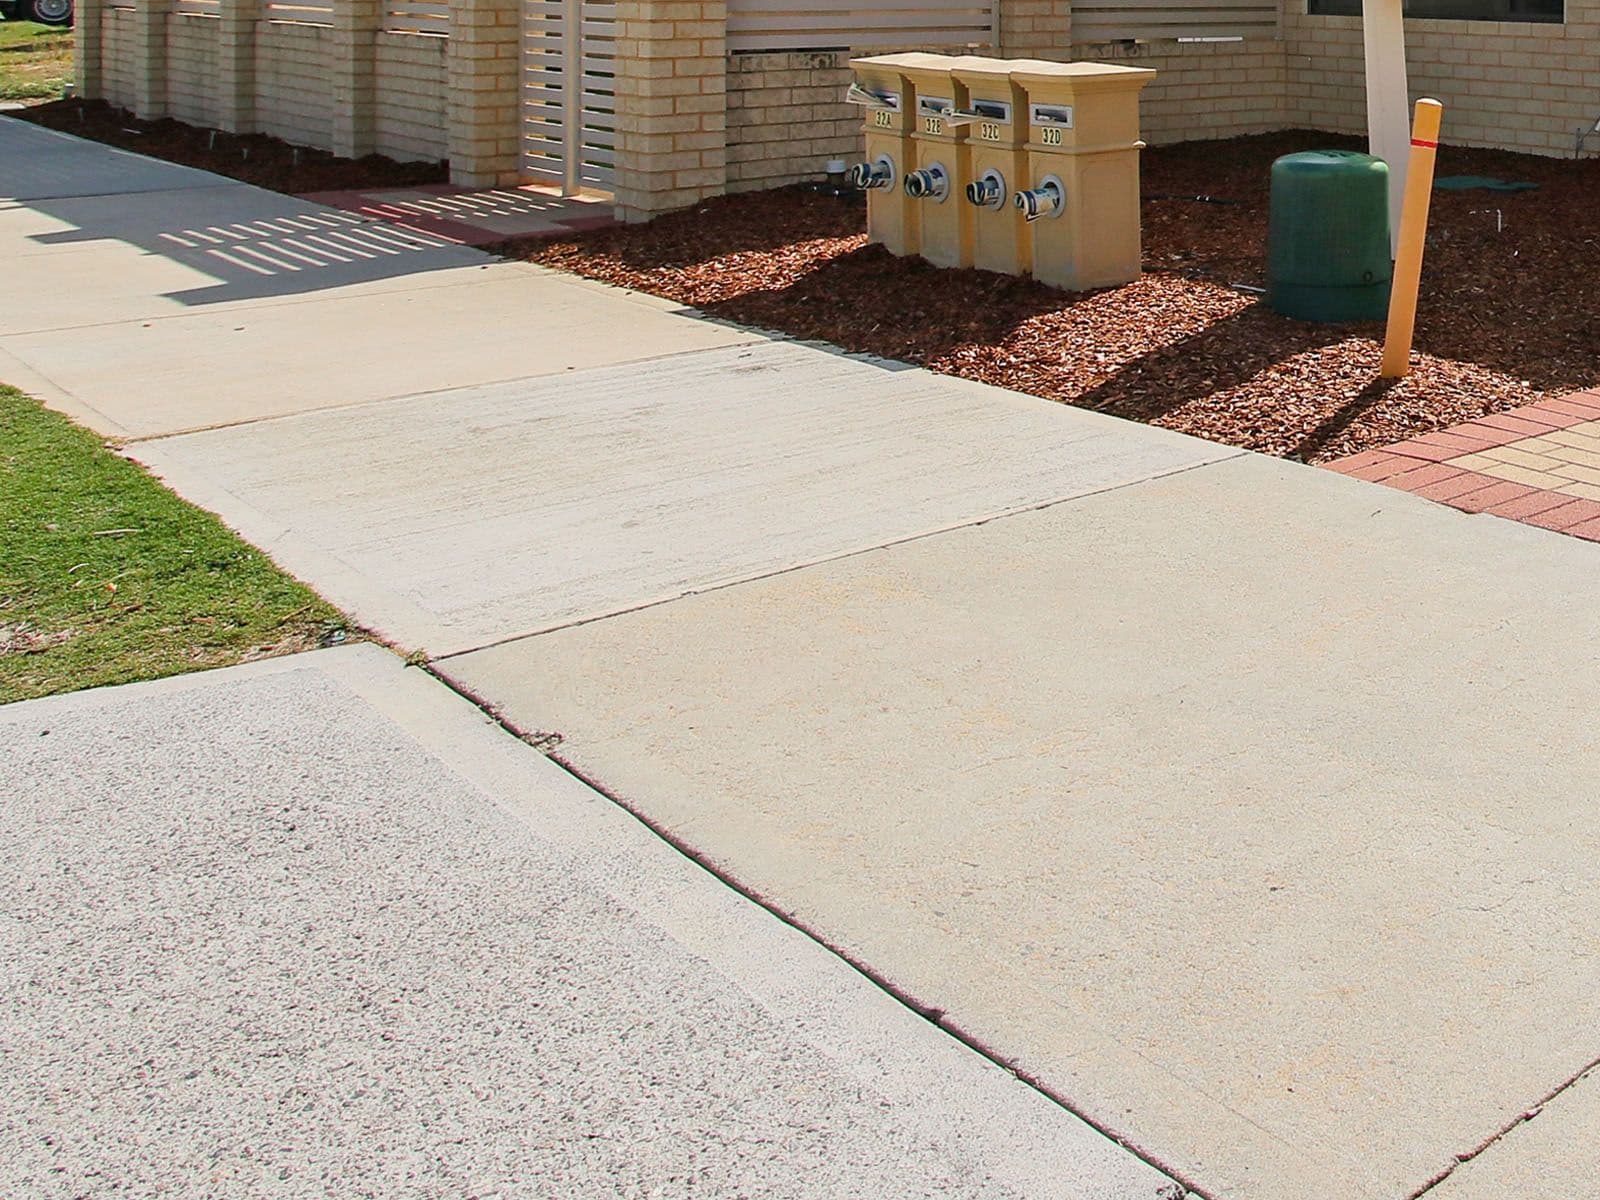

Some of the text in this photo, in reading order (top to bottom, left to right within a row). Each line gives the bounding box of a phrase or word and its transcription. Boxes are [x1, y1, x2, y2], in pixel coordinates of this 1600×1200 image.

[876, 111, 891, 126] 32A
[982, 123, 999, 140] 32C
[1043, 128, 1061, 144] 32D
